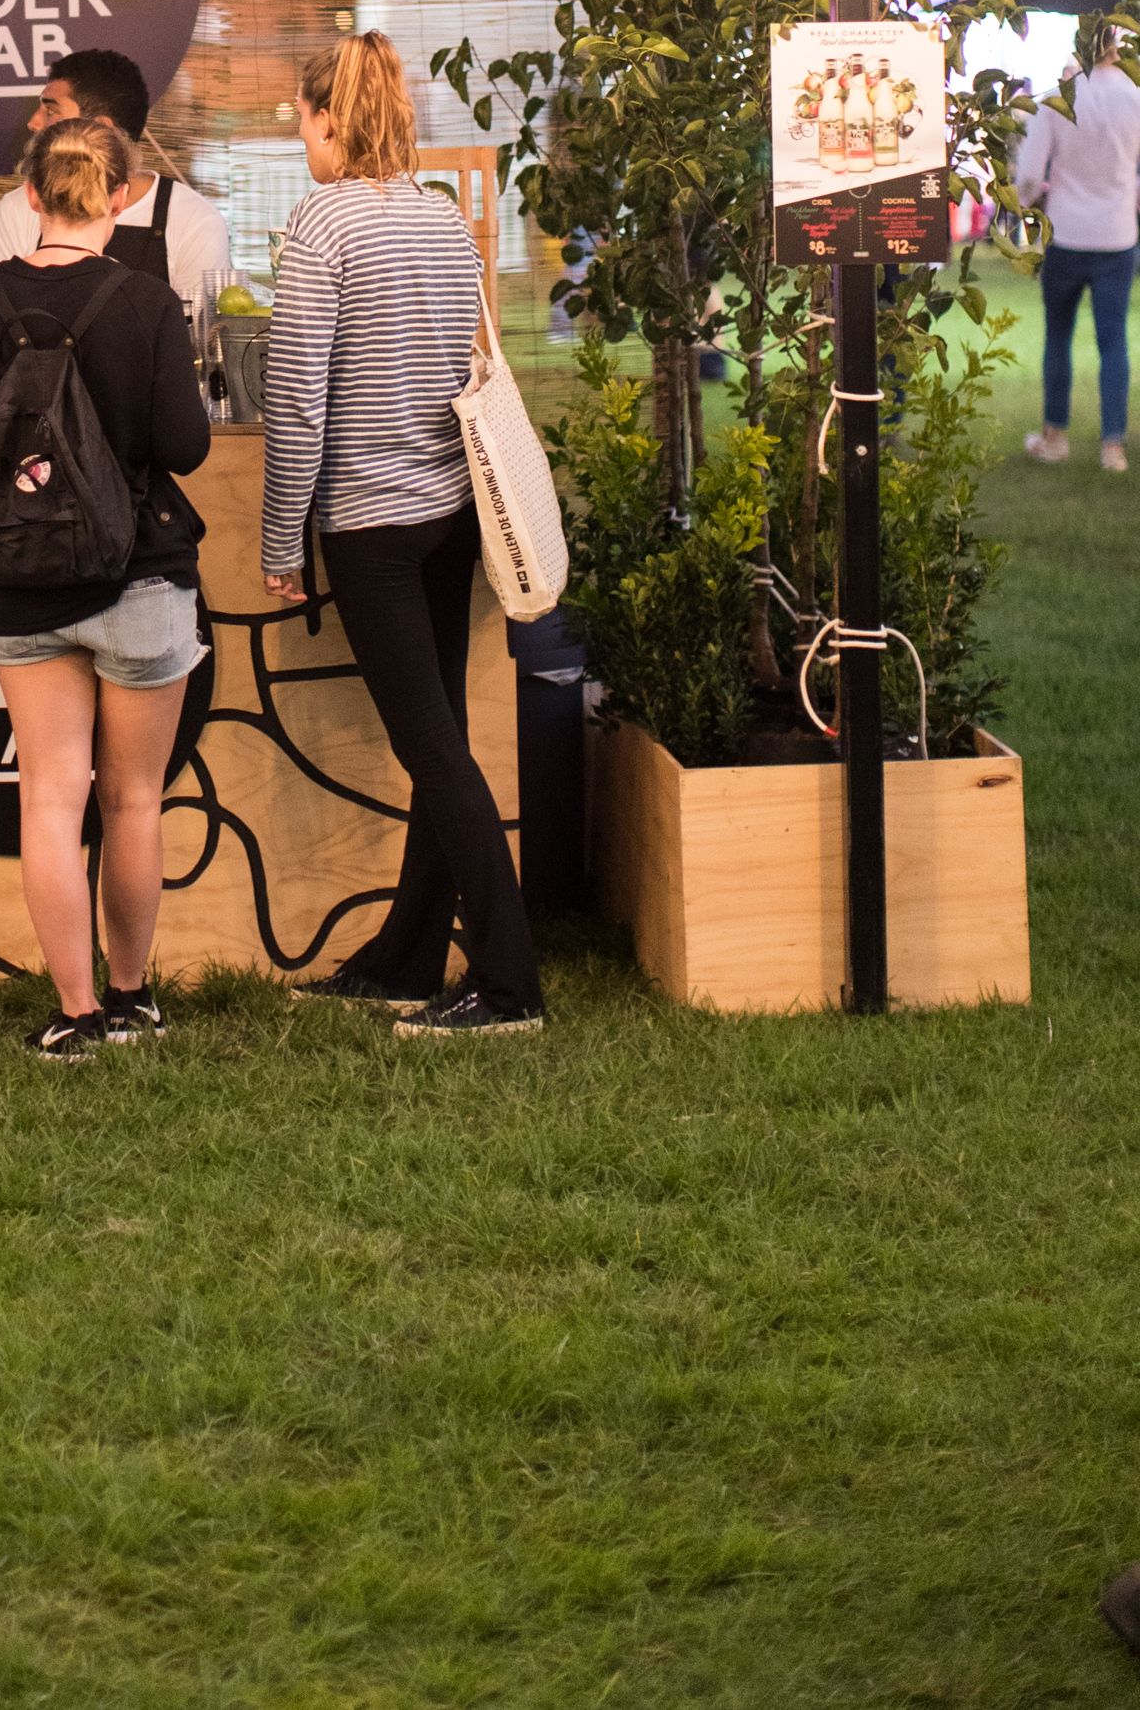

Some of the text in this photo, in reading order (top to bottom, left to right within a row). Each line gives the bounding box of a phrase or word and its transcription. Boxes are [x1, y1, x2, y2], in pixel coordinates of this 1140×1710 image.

[882, 197, 917, 205] COCKTAIL
[809, 240, 826, 256] $8
[887, 239, 910, 255] $12
[466, 415, 525, 570] WILLEM DE KOONING ACADEMIE
